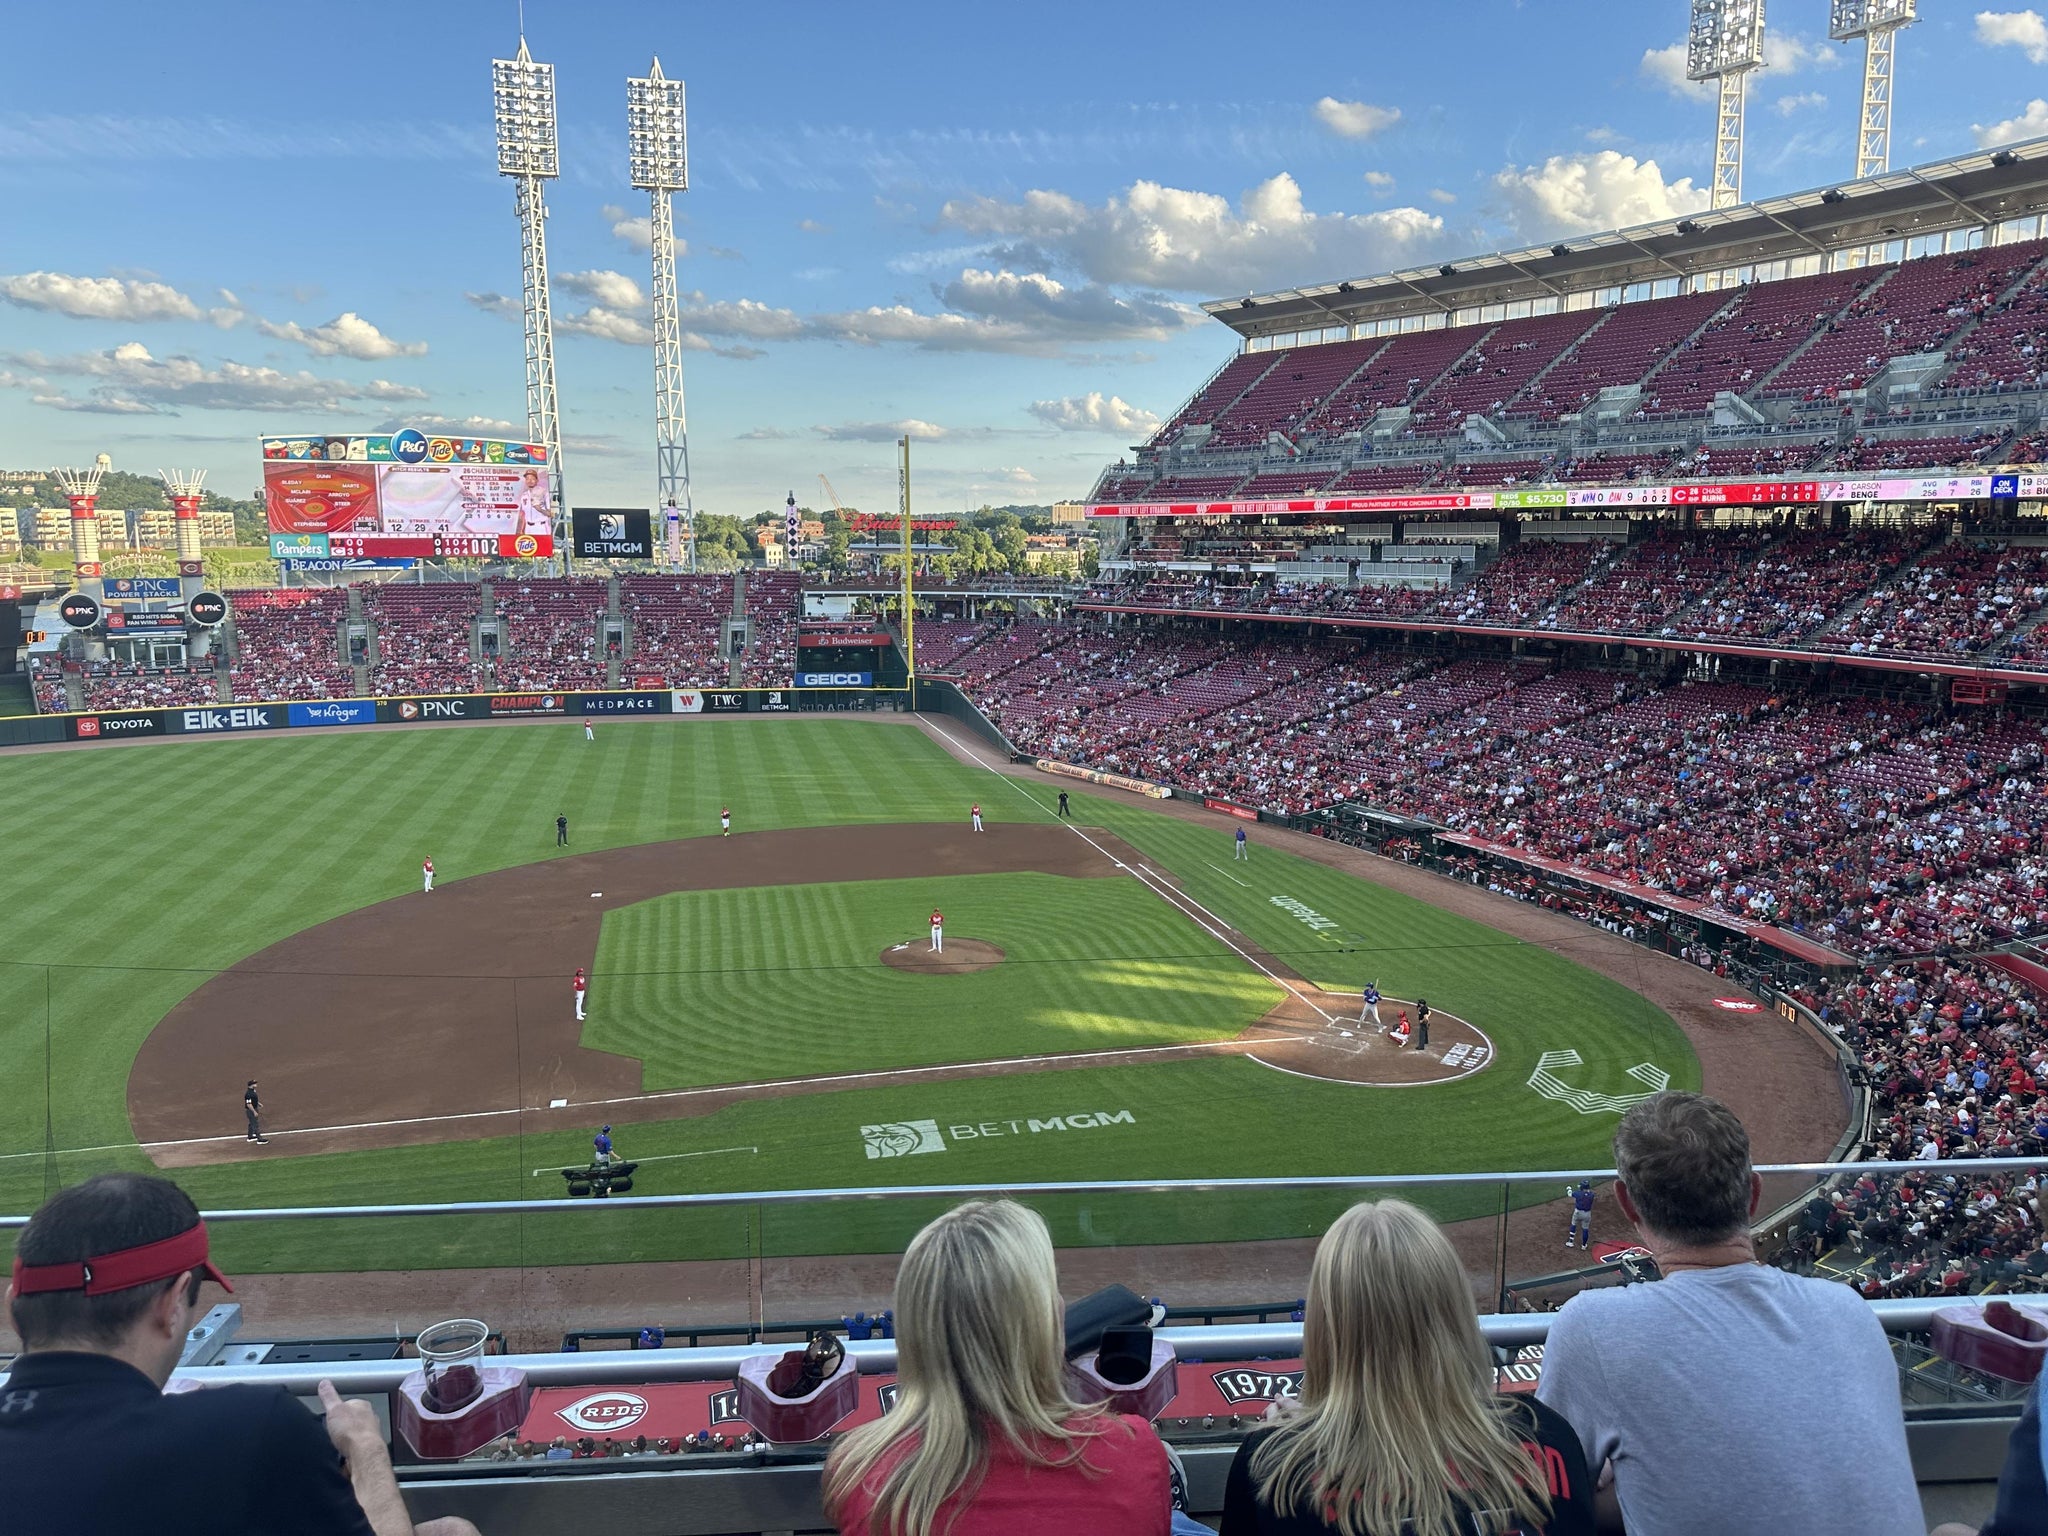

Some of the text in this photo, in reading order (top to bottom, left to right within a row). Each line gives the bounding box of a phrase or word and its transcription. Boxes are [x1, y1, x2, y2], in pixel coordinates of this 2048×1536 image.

[399, 440, 425, 453] P&G
[431, 444, 452, 457] Tide
[1839, 483, 1844, 491] 3
[2022, 478, 2032, 486] 19
[1850, 491, 1878, 499] BENGE
[1921, 489, 1937, 497] .256
[1993, 486, 2013, 494] DECK
[1526, 494, 1564, 504] $5,730
[1581, 493, 1596, 504] NYM
[1597, 493, 1604, 502] 0
[1608, 492, 1622, 501] CIN
[1627, 492, 1633, 500] 9
[1642, 495, 1648, 503] 0
[1651, 495, 1657, 503] 0
[1232, 504, 1245, 512] NEVER
[1255, 503, 1266, 512] LEFT
[391, 524, 449, 532] 12 29 41
[346, 538, 353, 546] 0
[356, 538, 364, 546] 0
[434, 538, 441, 546] 0
[471, 539, 498, 554] 0 0 2
[517, 539, 536, 551] Tide
[584, 542, 643, 553] BETMGM
[276, 541, 323, 556] Pampers
[347, 547, 468, 555] 3 6 9 6 0 4
[290, 559, 341, 571] BEACON
[1135, 561, 1166, 571] handlebar
[133, 580, 169, 591] PNC
[143, 590, 178, 598] STACKS
[74, 607, 94, 615] PNC
[204, 604, 222, 612] PNC
[831, 636, 874, 645] Budweiser
[804, 673, 862, 685] GEICO
[586, 698, 654, 709] MEDPACE
[711, 694, 742, 706] TWC
[323, 704, 359, 722] Kroger
[421, 701, 465, 717] PNC
[103, 718, 153, 730] TOYOTA
[183, 708, 269, 730] Elk+Elk
[1268, 895, 1340, 931] TriHealth
[949, 1109, 1136, 1140] BETMGM
[1221, 1373, 1298, 1397] 1972
[583, 1405, 644, 1417] REDS
